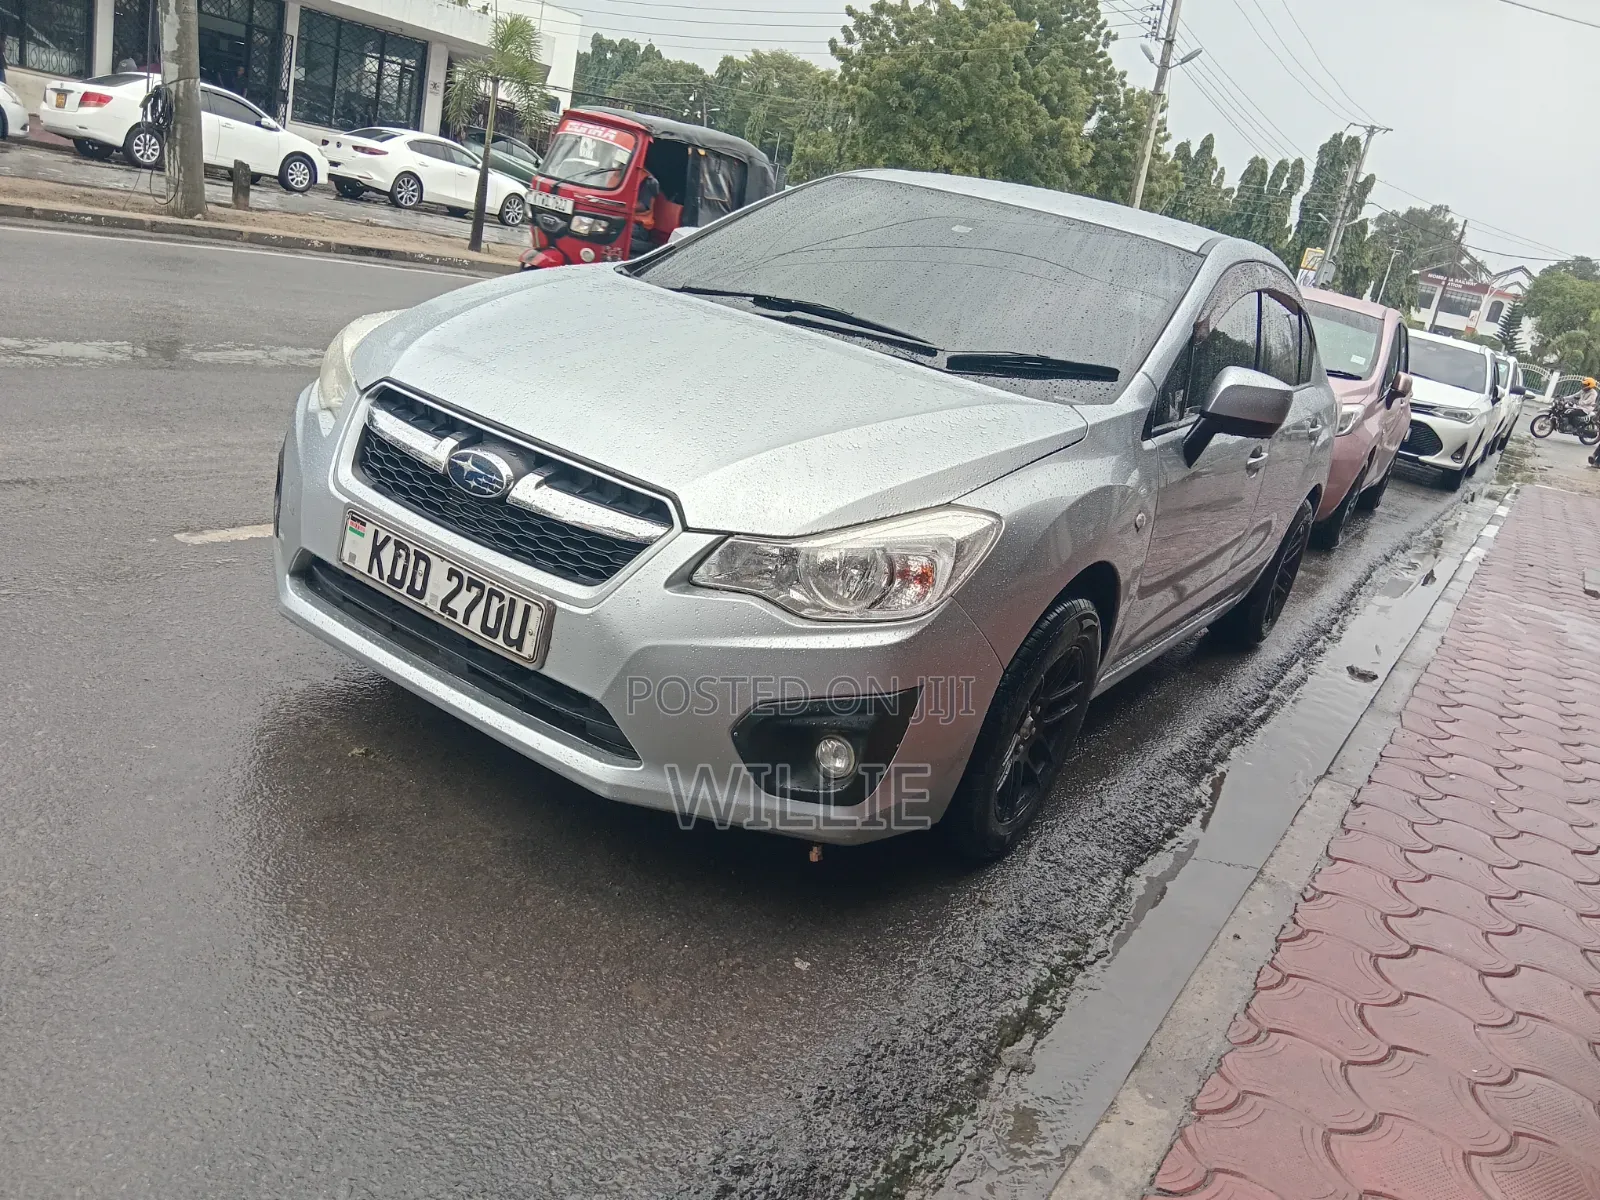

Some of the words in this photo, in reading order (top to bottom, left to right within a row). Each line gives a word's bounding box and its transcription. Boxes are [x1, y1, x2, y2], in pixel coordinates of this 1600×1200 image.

[1441, 280, 1463, 289] SATION
[367, 528, 432, 601] KDD
[438, 566, 532, 652] 270U
